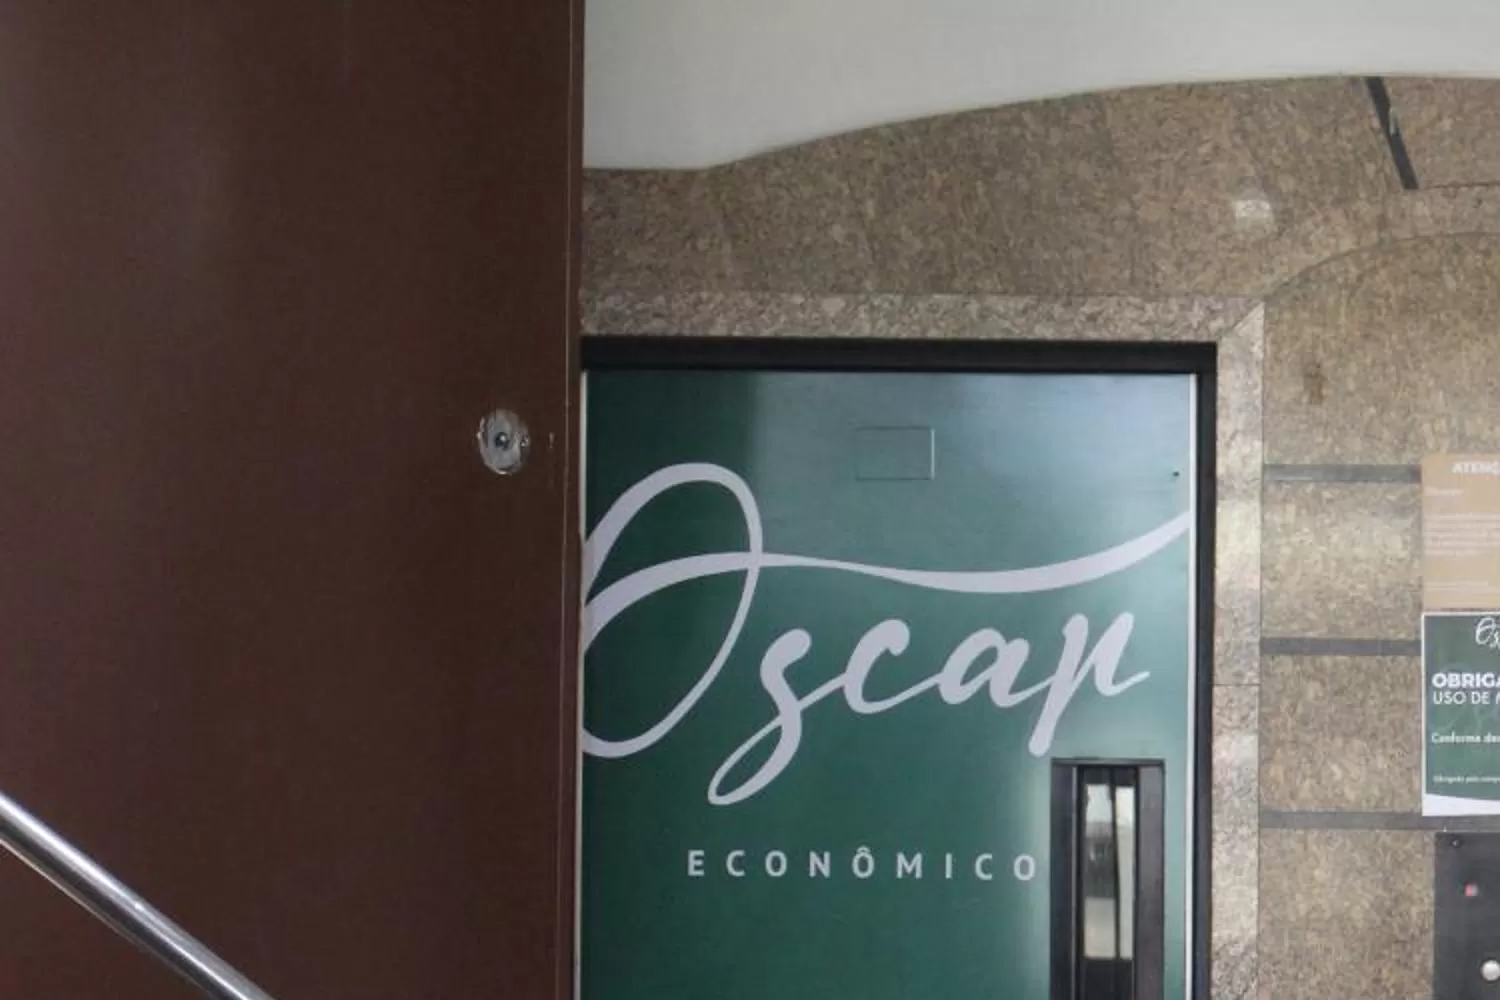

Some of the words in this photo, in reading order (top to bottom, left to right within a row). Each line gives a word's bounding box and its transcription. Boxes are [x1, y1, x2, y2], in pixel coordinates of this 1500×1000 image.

[1433, 690, 1466, 705] USO
[1472, 691, 1490, 705] DE
[688, 847, 1036, 881] ECONÔMICO
